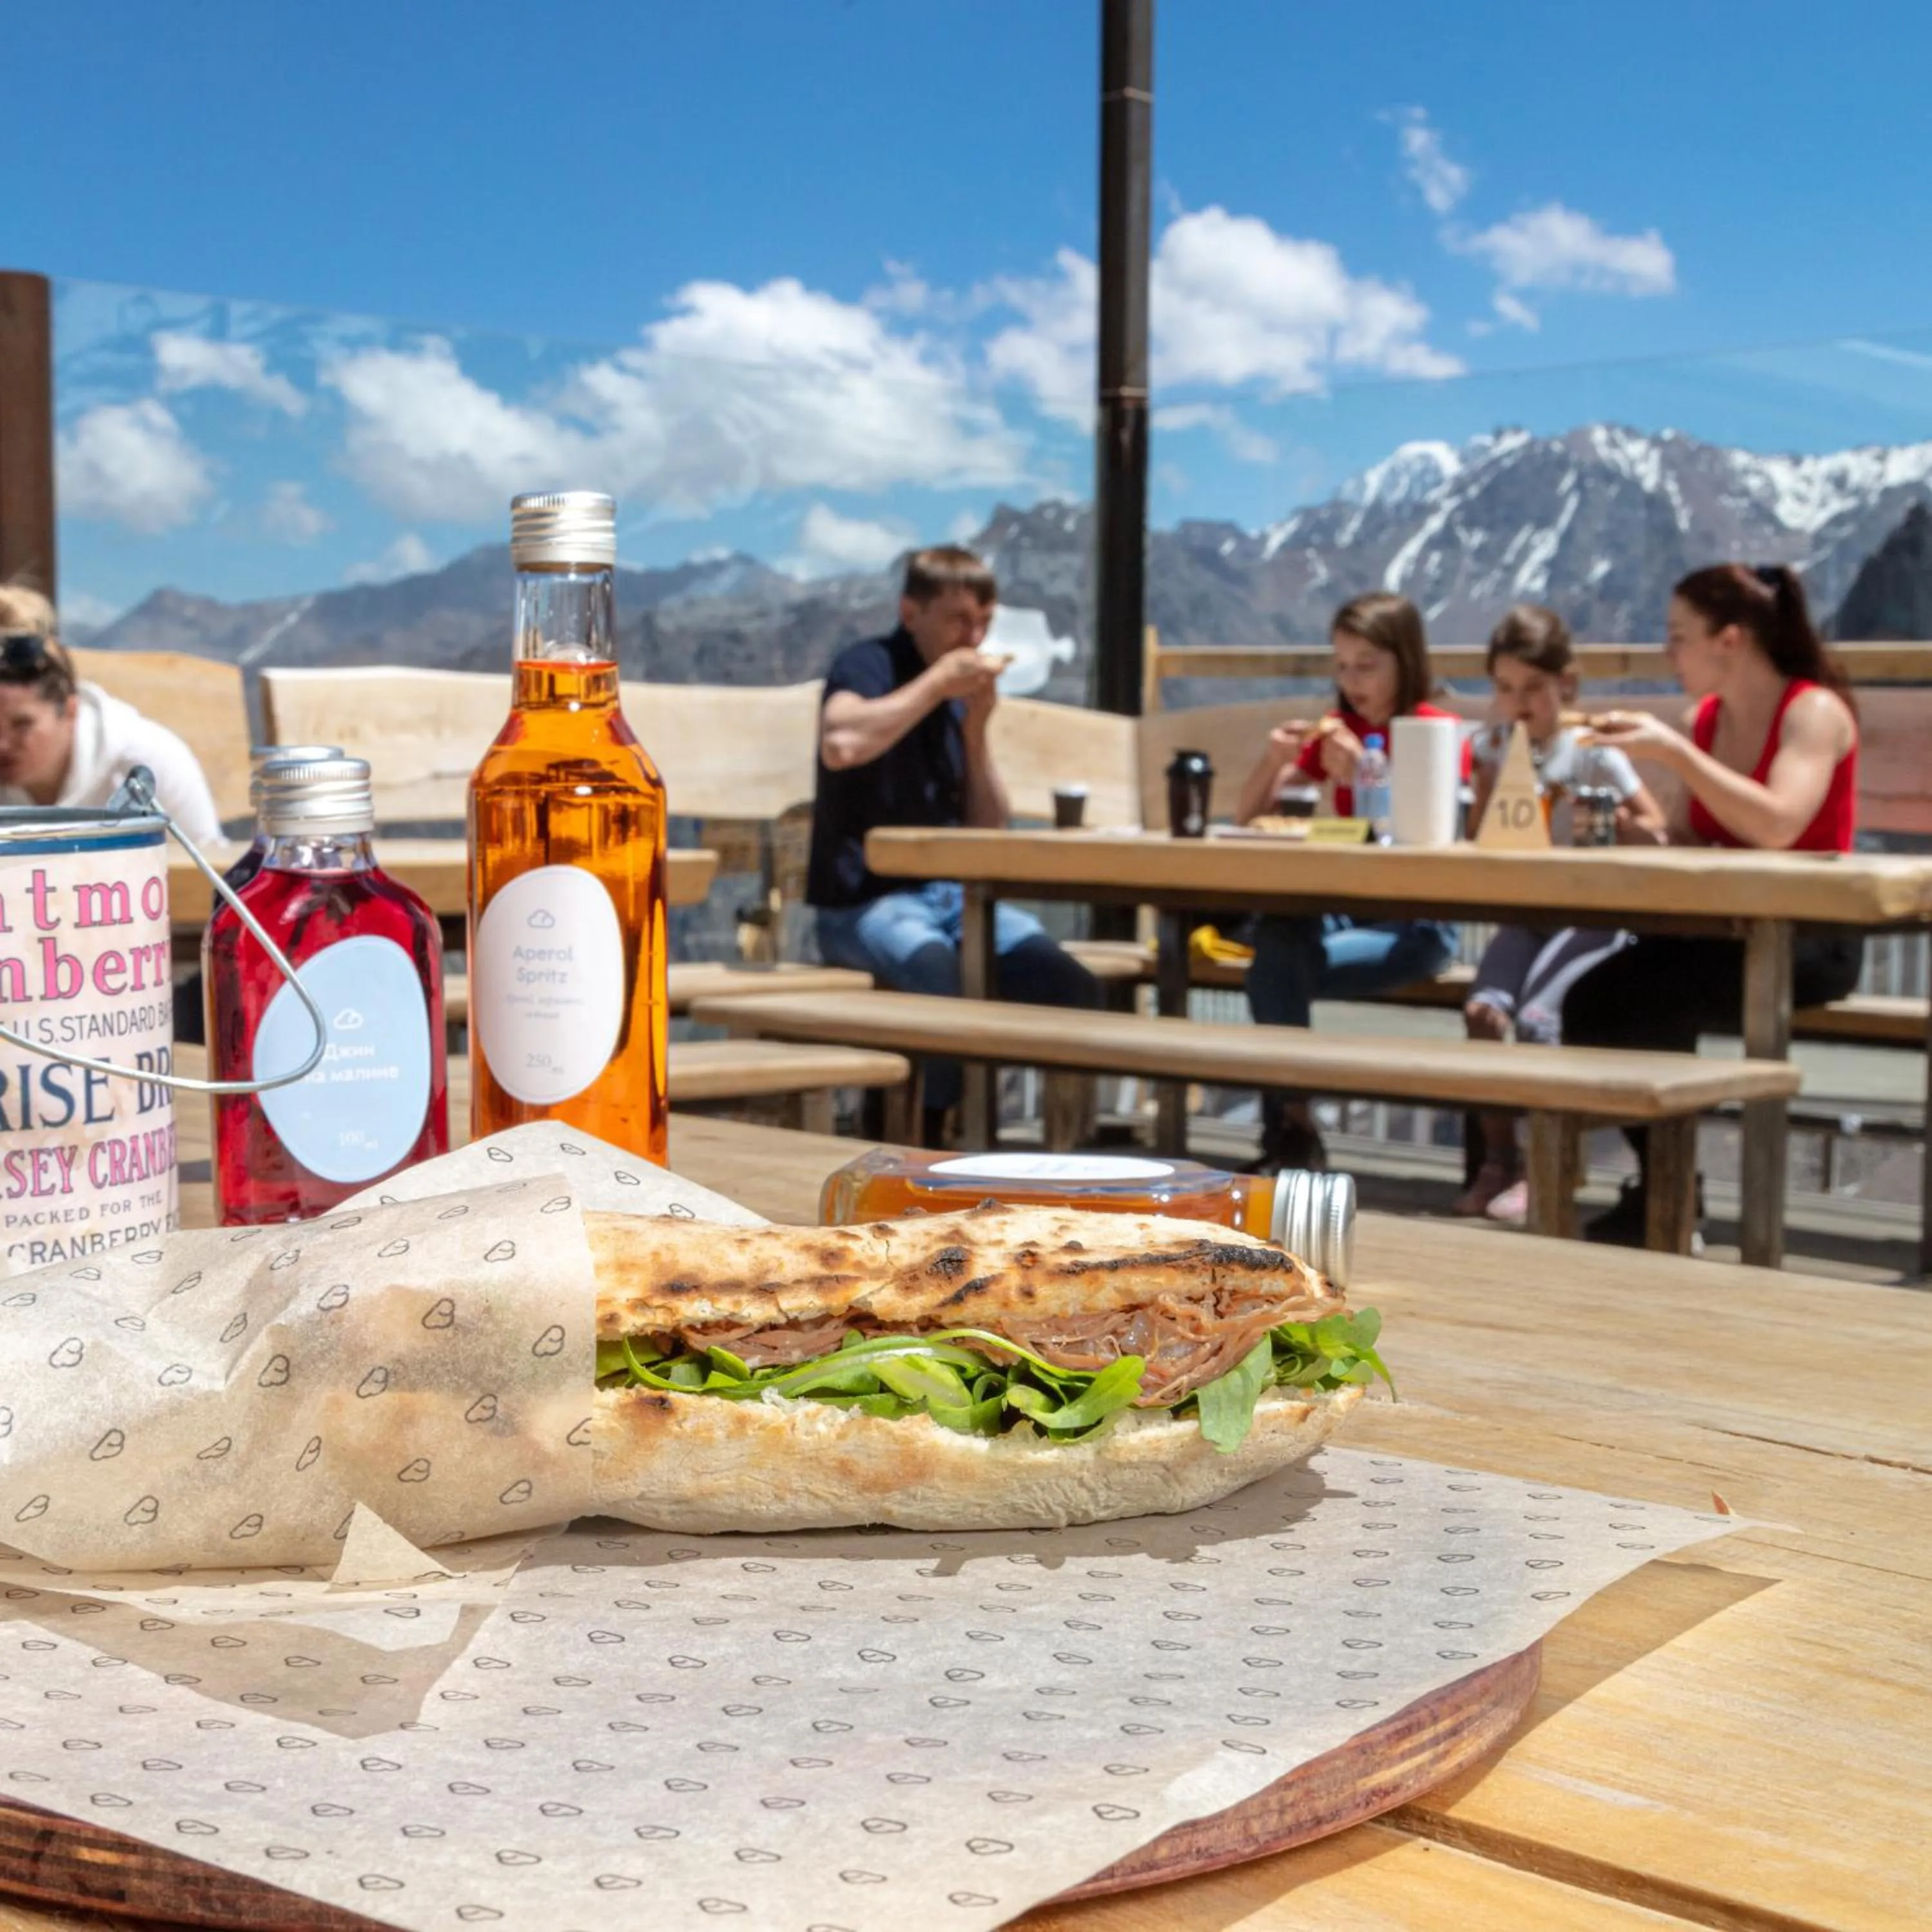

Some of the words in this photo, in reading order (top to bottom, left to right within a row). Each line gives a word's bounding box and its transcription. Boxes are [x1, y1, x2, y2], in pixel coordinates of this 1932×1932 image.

[1497, 797, 1537, 831] 10
[0, 869, 164, 932] tmo
[0, 936, 171, 1003] nberr
[513, 945, 574, 965] Aperol
[516, 966, 567, 985] Spritz
[322, 1043, 375, 1063] Джин
[0, 1145, 78, 1199] SEY
[5, 1208, 90, 1227] PACKED
[100, 1200, 132, 1217] FOR
[139, 1189, 162, 1209] THE
